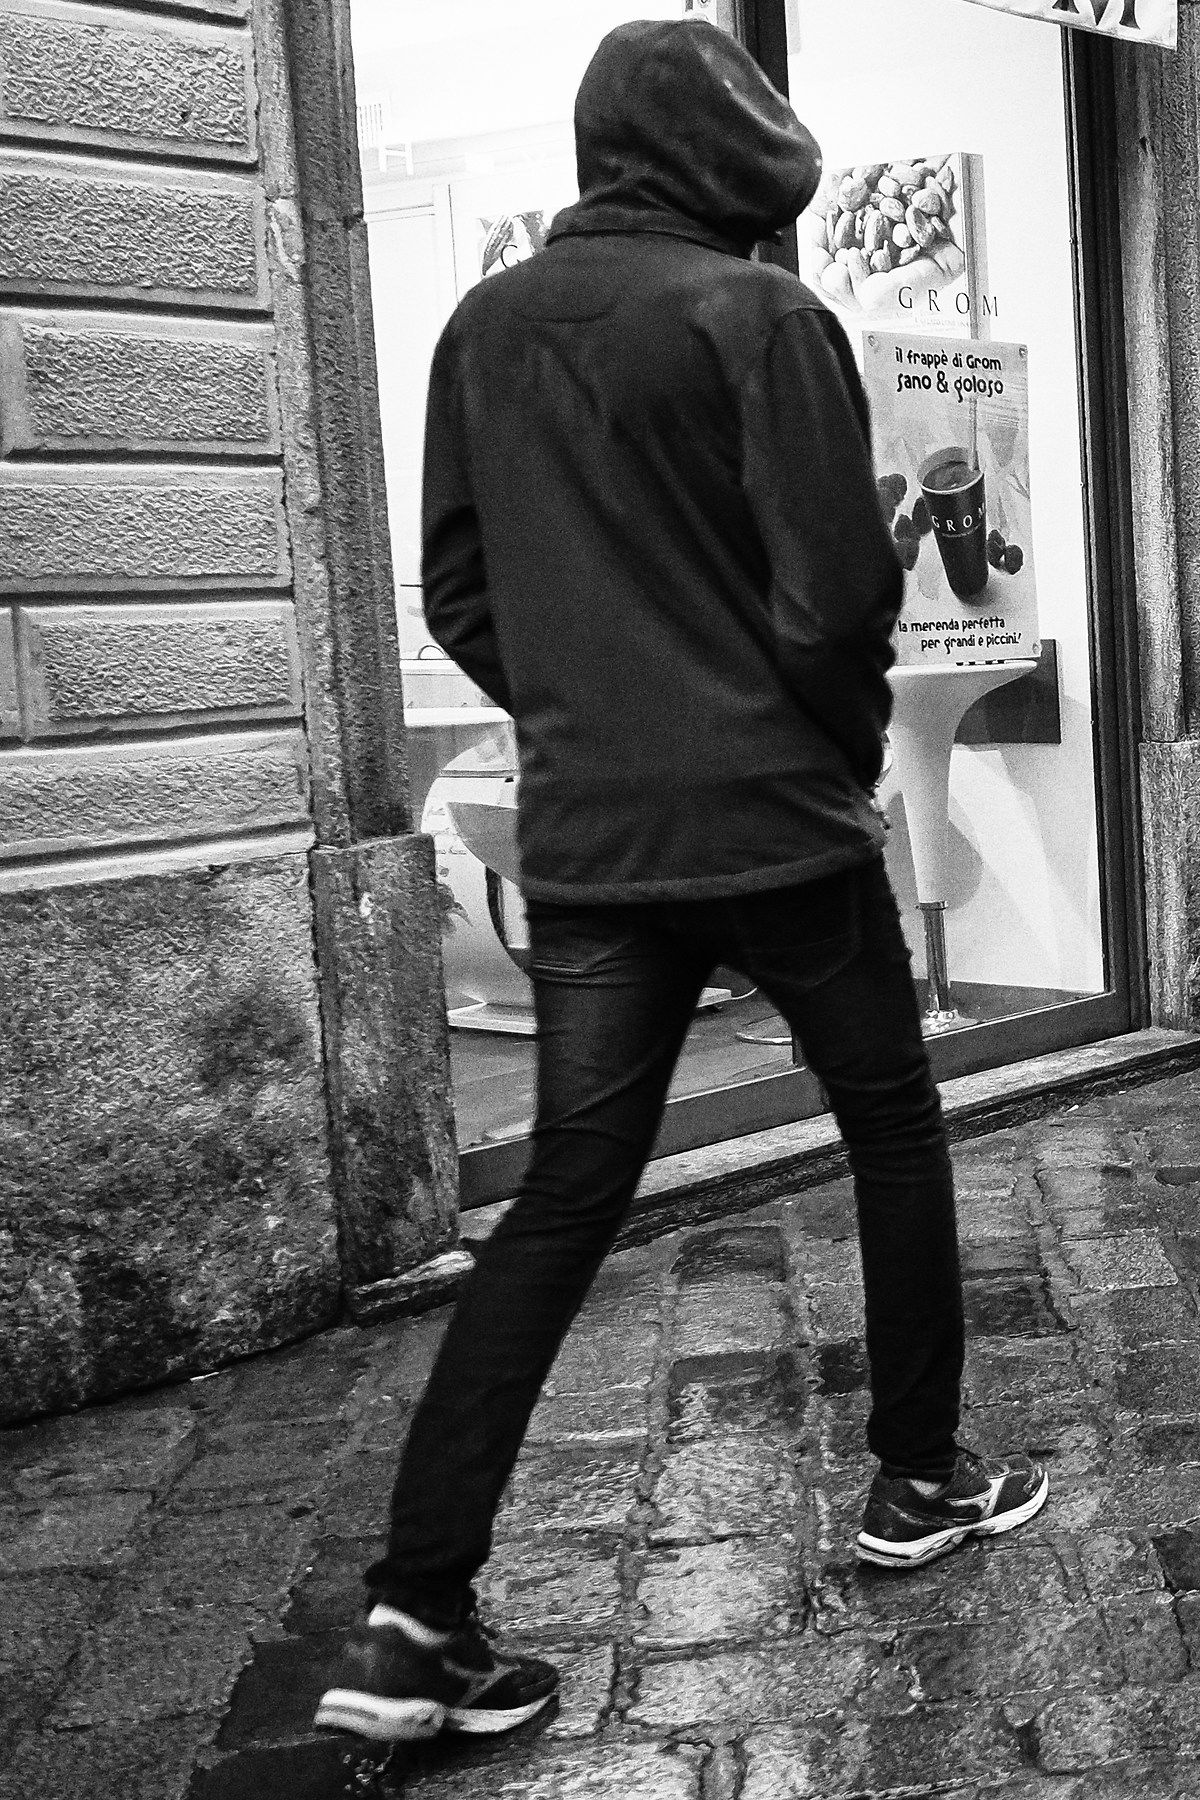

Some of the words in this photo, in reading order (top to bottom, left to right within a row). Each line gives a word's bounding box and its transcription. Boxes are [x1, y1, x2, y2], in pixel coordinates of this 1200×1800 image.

[898, 286, 998, 317] GROM
[895, 346, 903, 364] il
[907, 349, 949, 370] frappè
[952, 352, 963, 369] di
[966, 354, 1003, 371] Grom
[897, 373, 932, 393] sano
[936, 370, 950, 394] &
[954, 374, 1004, 404] goloso
[898, 620, 908, 633] la
[911, 619, 960, 633] merenda
[961, 616, 1006, 633] perfetta
[921, 639, 941, 652] per
[943, 634, 976, 655] grandi
[978, 637, 985, 647] e
[986, 631, 1022, 649] piccini!
